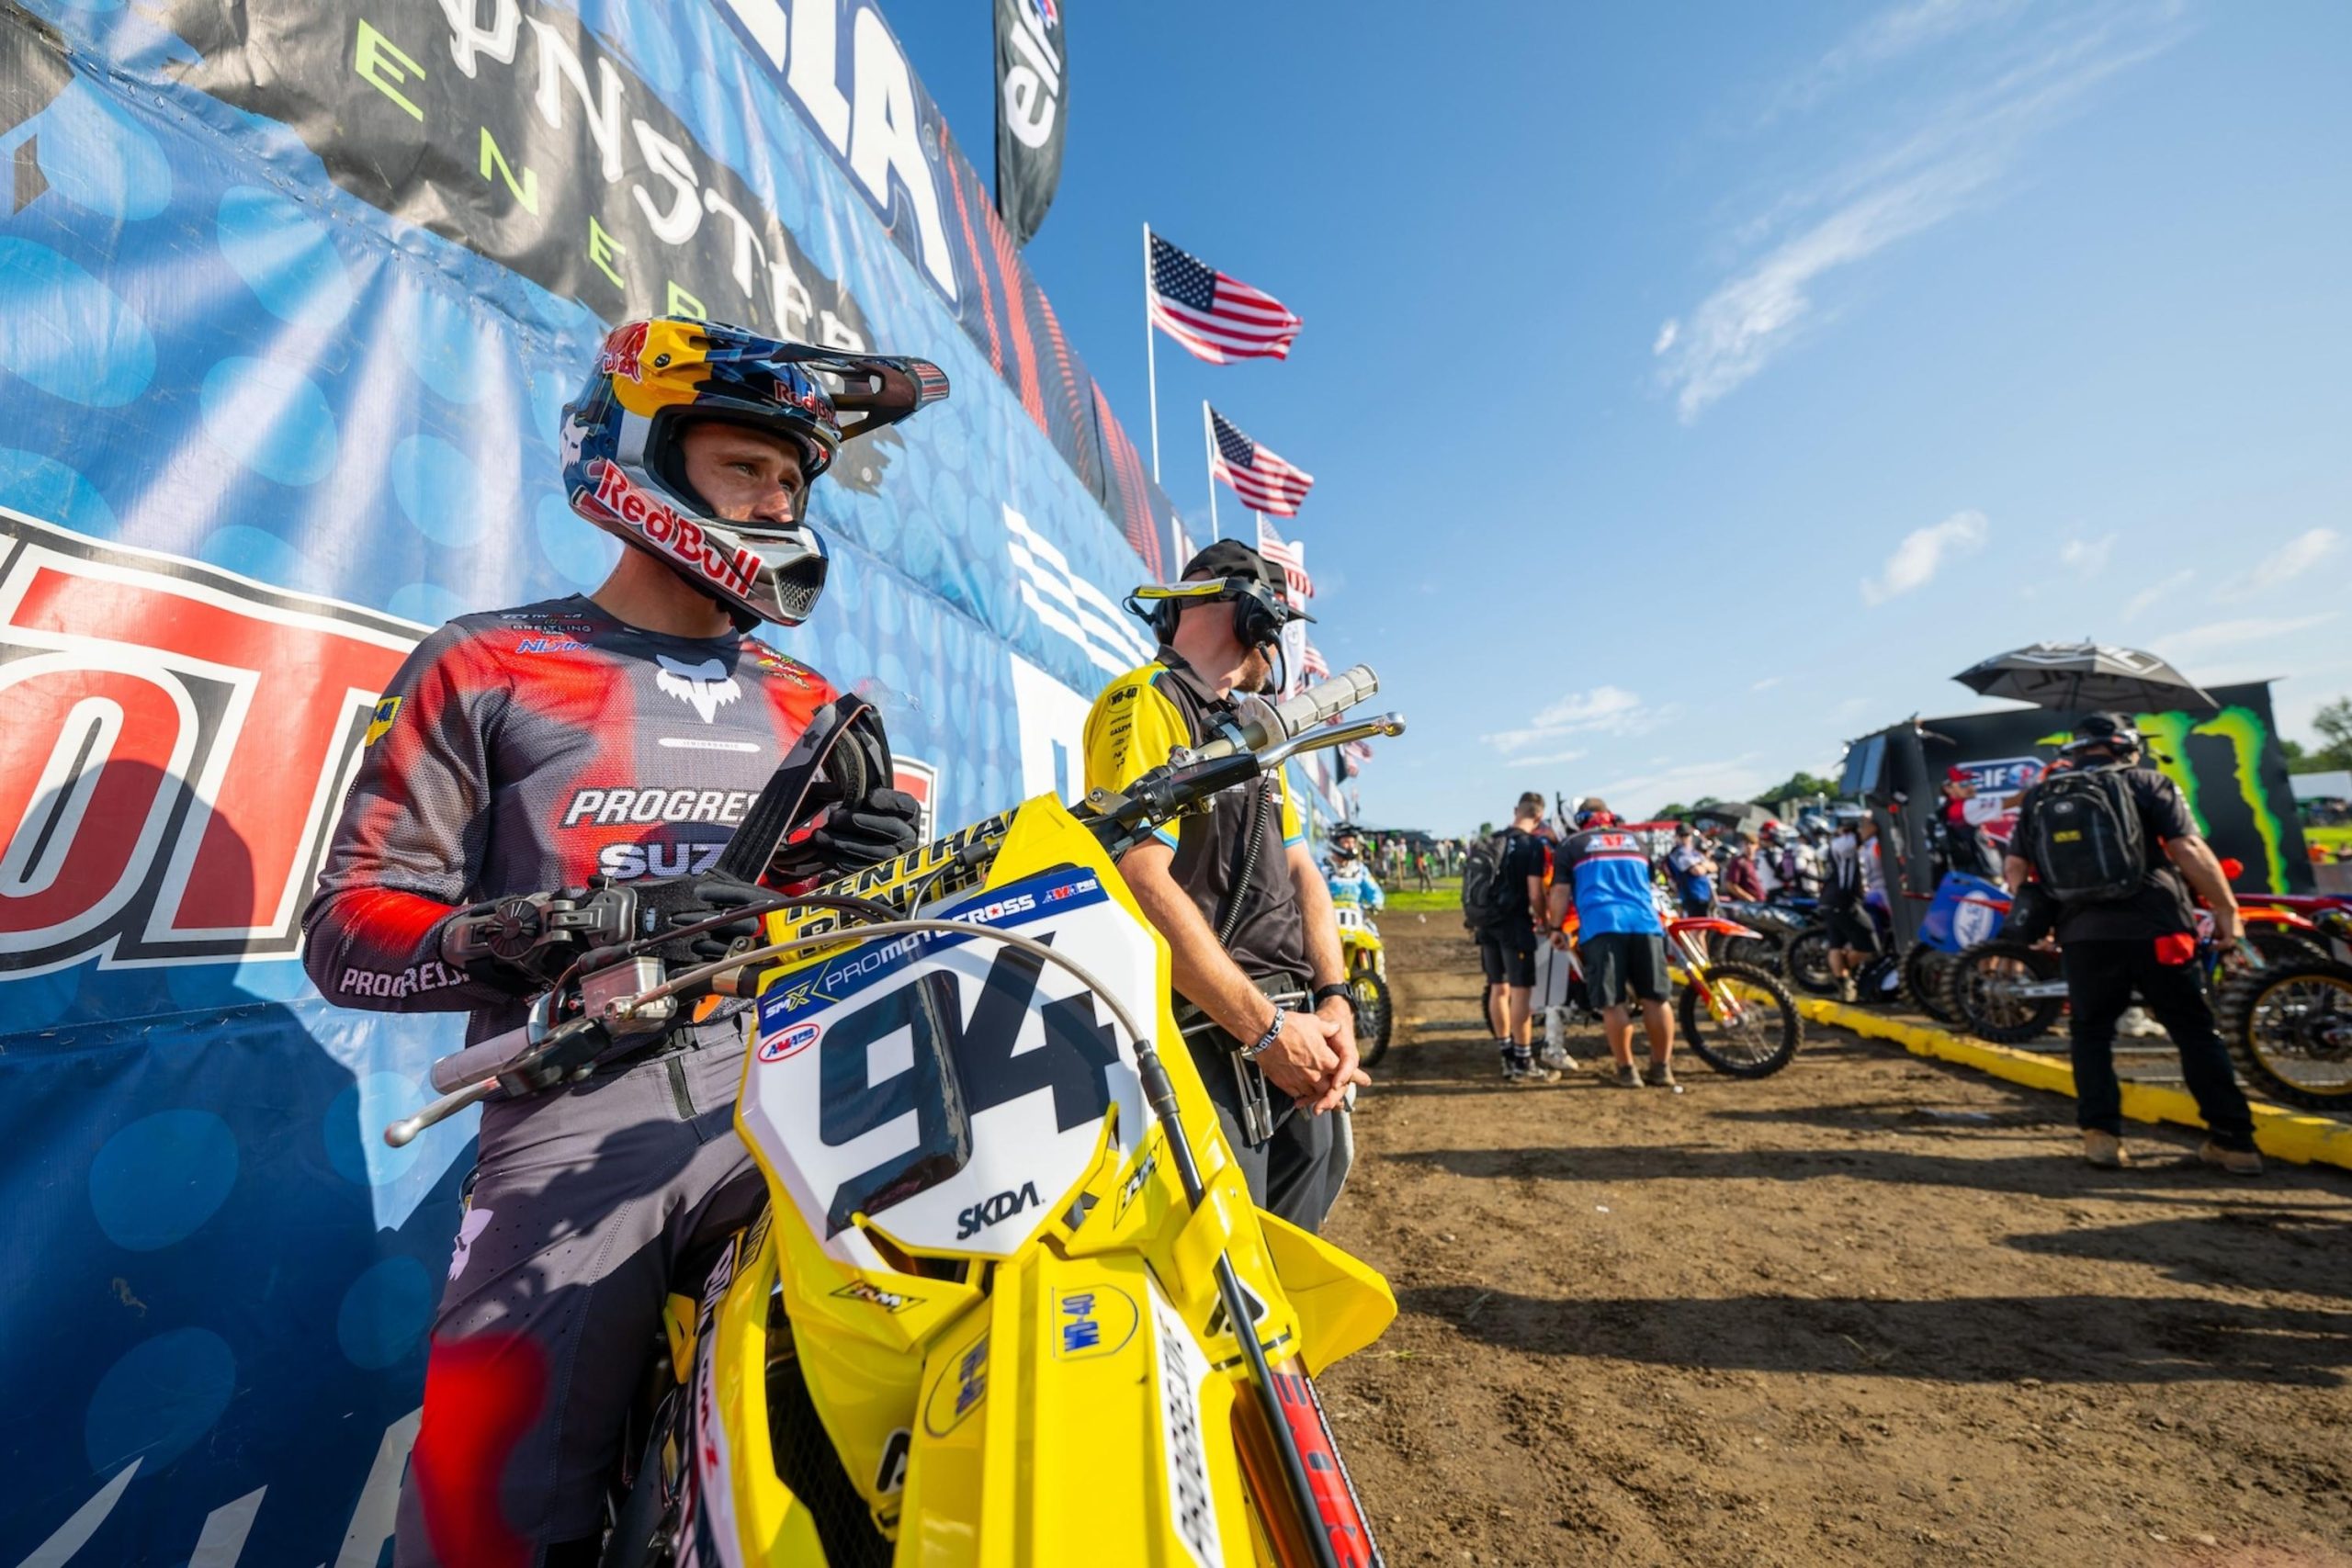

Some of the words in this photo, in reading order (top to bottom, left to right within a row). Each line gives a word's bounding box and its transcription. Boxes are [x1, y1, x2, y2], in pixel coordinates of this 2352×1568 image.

[594, 459, 674, 545] Red
[673, 515, 764, 598] Bull
[820, 931, 1123, 1242] 94
